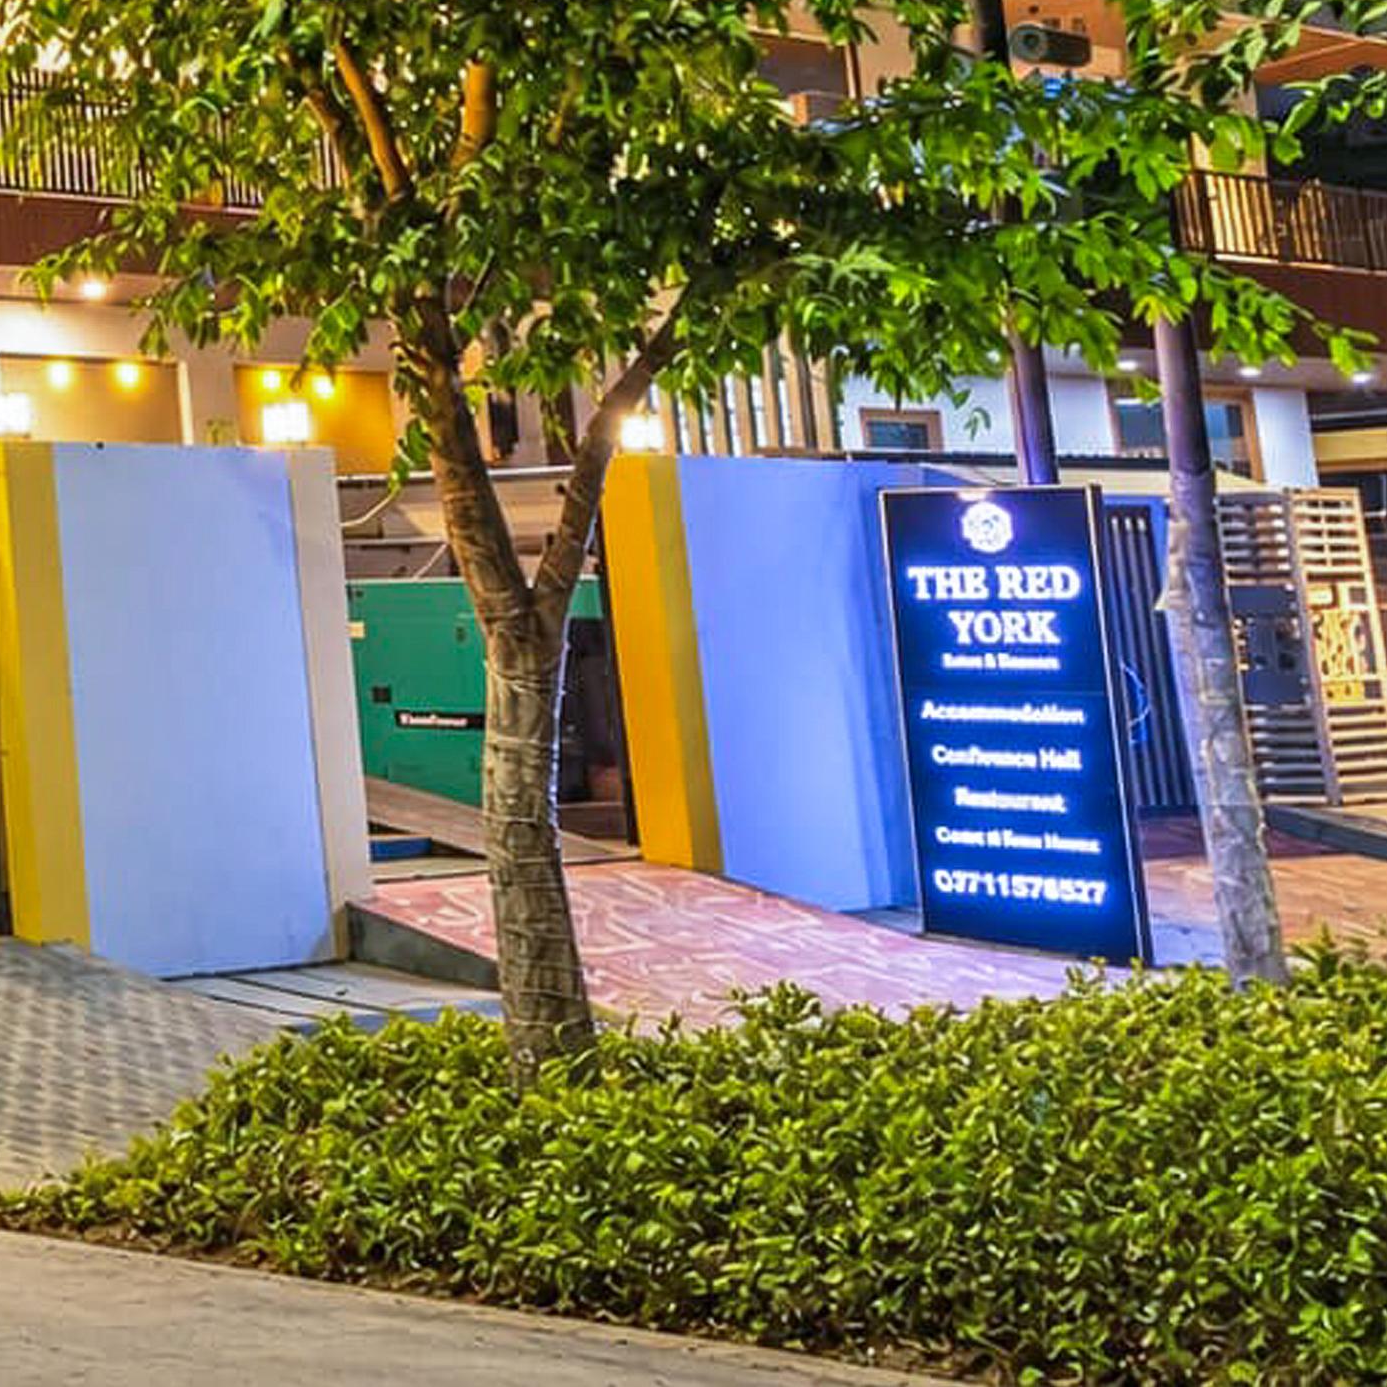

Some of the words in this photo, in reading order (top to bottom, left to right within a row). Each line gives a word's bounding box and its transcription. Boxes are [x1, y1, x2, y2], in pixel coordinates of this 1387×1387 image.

[906, 565, 989, 600] THE
[995, 565, 1081, 600] RED
[948, 610, 1061, 644] YORK
